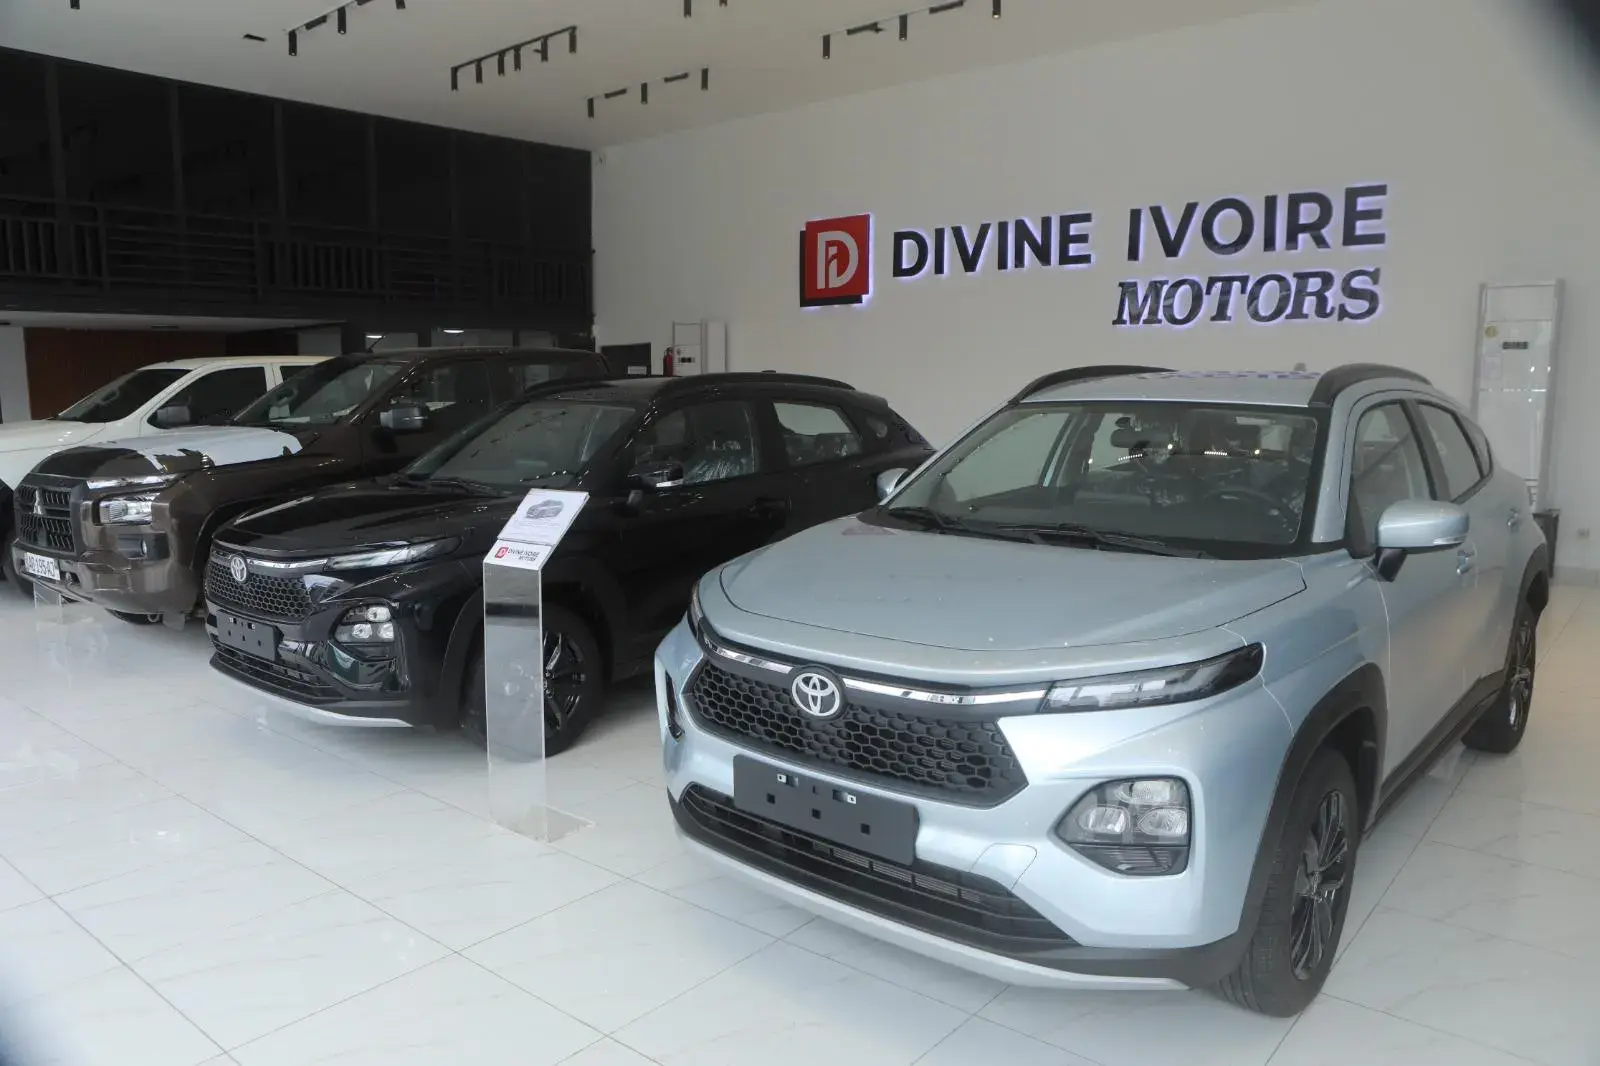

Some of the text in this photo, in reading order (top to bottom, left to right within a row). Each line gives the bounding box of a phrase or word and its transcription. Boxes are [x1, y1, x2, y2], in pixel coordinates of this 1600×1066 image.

[893, 184, 1387, 277] DIVINE IVOIRE
[1112, 267, 1381, 325] MOTORS
